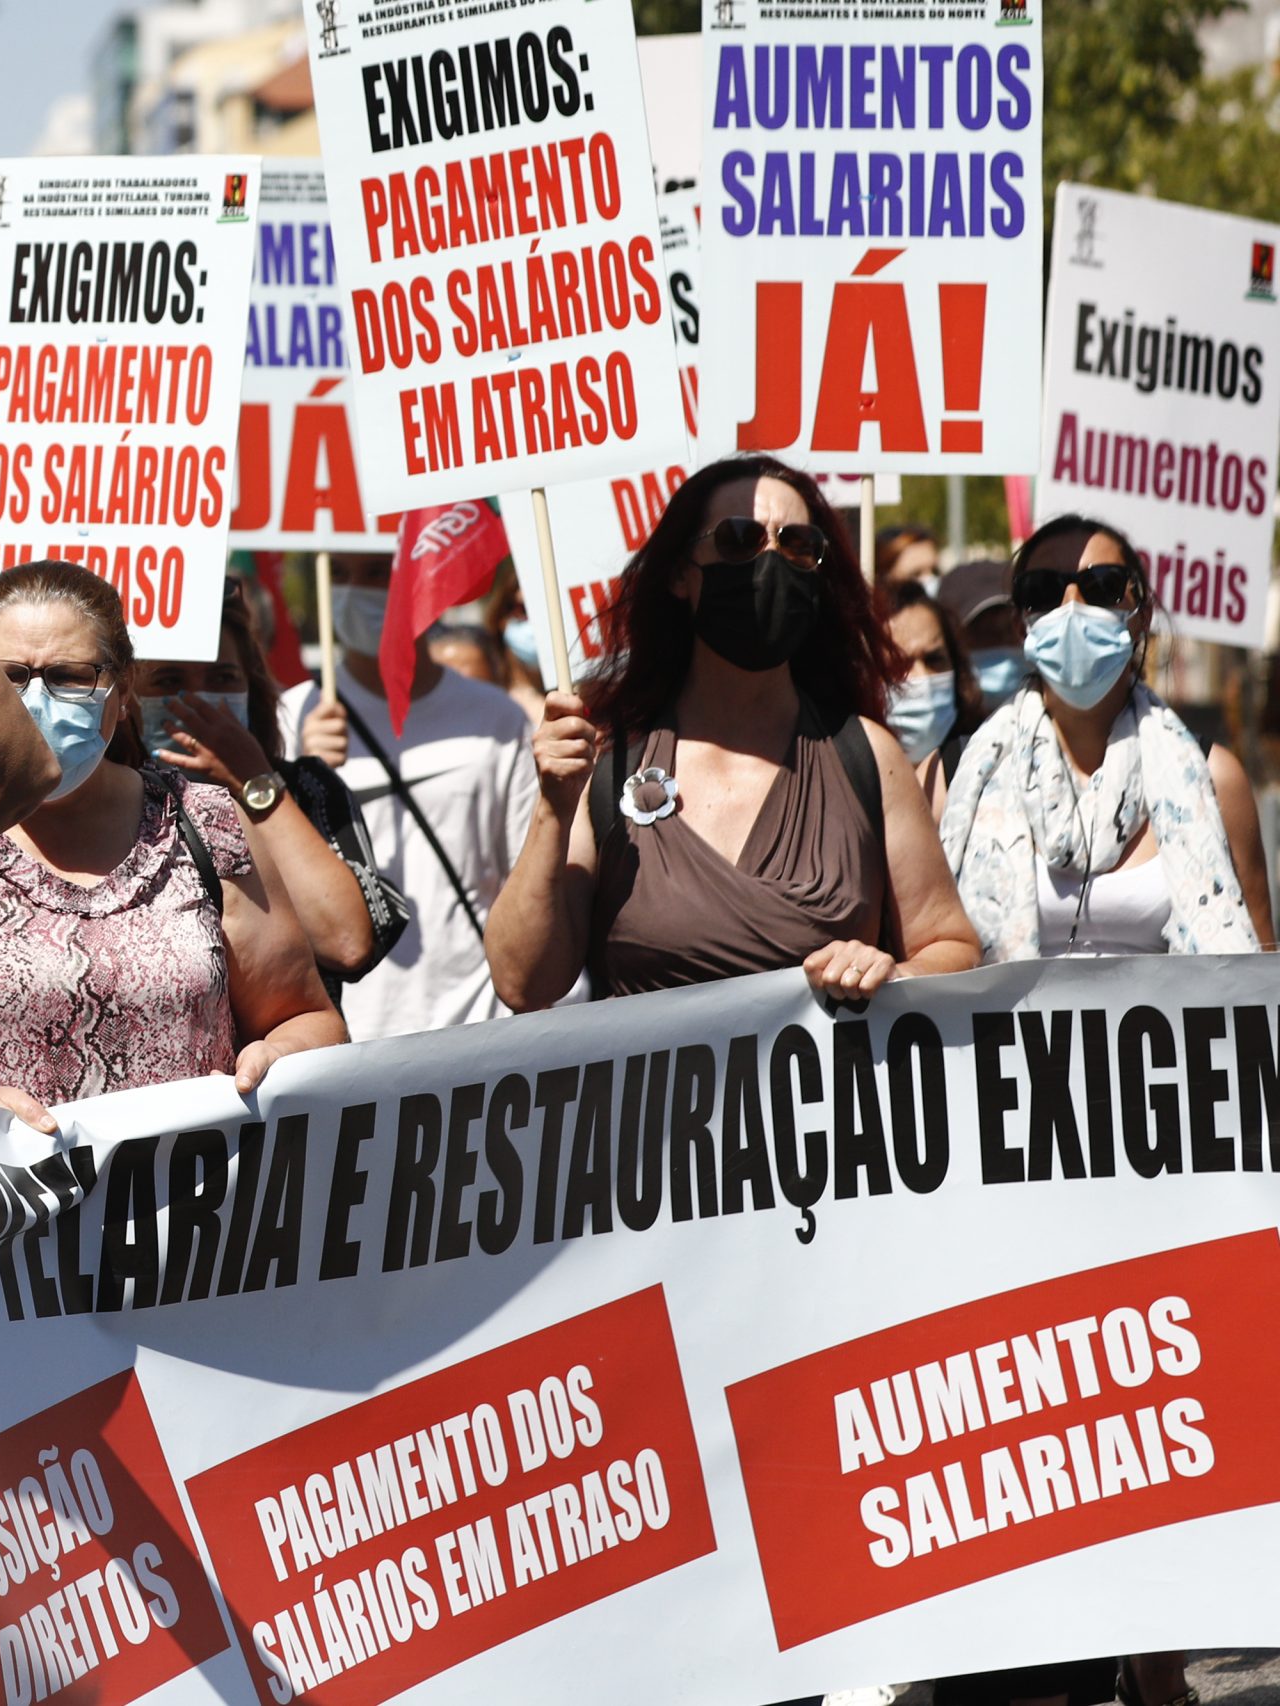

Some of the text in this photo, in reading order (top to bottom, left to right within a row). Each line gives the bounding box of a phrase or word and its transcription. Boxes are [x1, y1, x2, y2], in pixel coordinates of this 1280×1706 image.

[362, 13, 446, 38] RESTAURANTES
[448, 10, 454, 20] E
[457, 0, 517, 18] SIMILARES
[760, 9, 986, 18] RESTAURANTES E SIMILARES DO NORTE
[361, 25, 594, 153] EXIGIMOS:
[714, 43, 1032, 131] AUMENTOS
[23, 208, 95, 217] RESTAURANTES
[105, 207, 157, 216] SIMILARES
[177, 207, 209, 216] NORTE
[39, 179, 89, 189] SINDICATO
[115, 178, 198, 188] TRABALHADORES
[360, 131, 621, 264] PAGAMENTO
[721, 150, 1025, 239] SALARIAIS
[9, 240, 207, 324] EXIGIMOS:
[351, 273, 442, 375] DOS
[446, 235, 661, 364] SALÁRIOS
[736, 247, 987, 454] JÁ!
[1073, 301, 1264, 406] Exigimos
[398, 350, 638, 476] EM ATRASO
[1052, 411, 1267, 517] Aumentos
[41, 431, 225, 528] SALÁRIOS
[320, 1102, 377, 1281] E
[382, 998, 950, 1274] RESTAURAÇÃO
[833, 1295, 1201, 1475] AUMENTOS
[254, 1364, 604, 1582] PAGAMENTO DOS
[860, 1397, 1215, 1569] SALARIAIS
[252, 1448, 671, 1706] SALÁRIOS EM ATRASO
